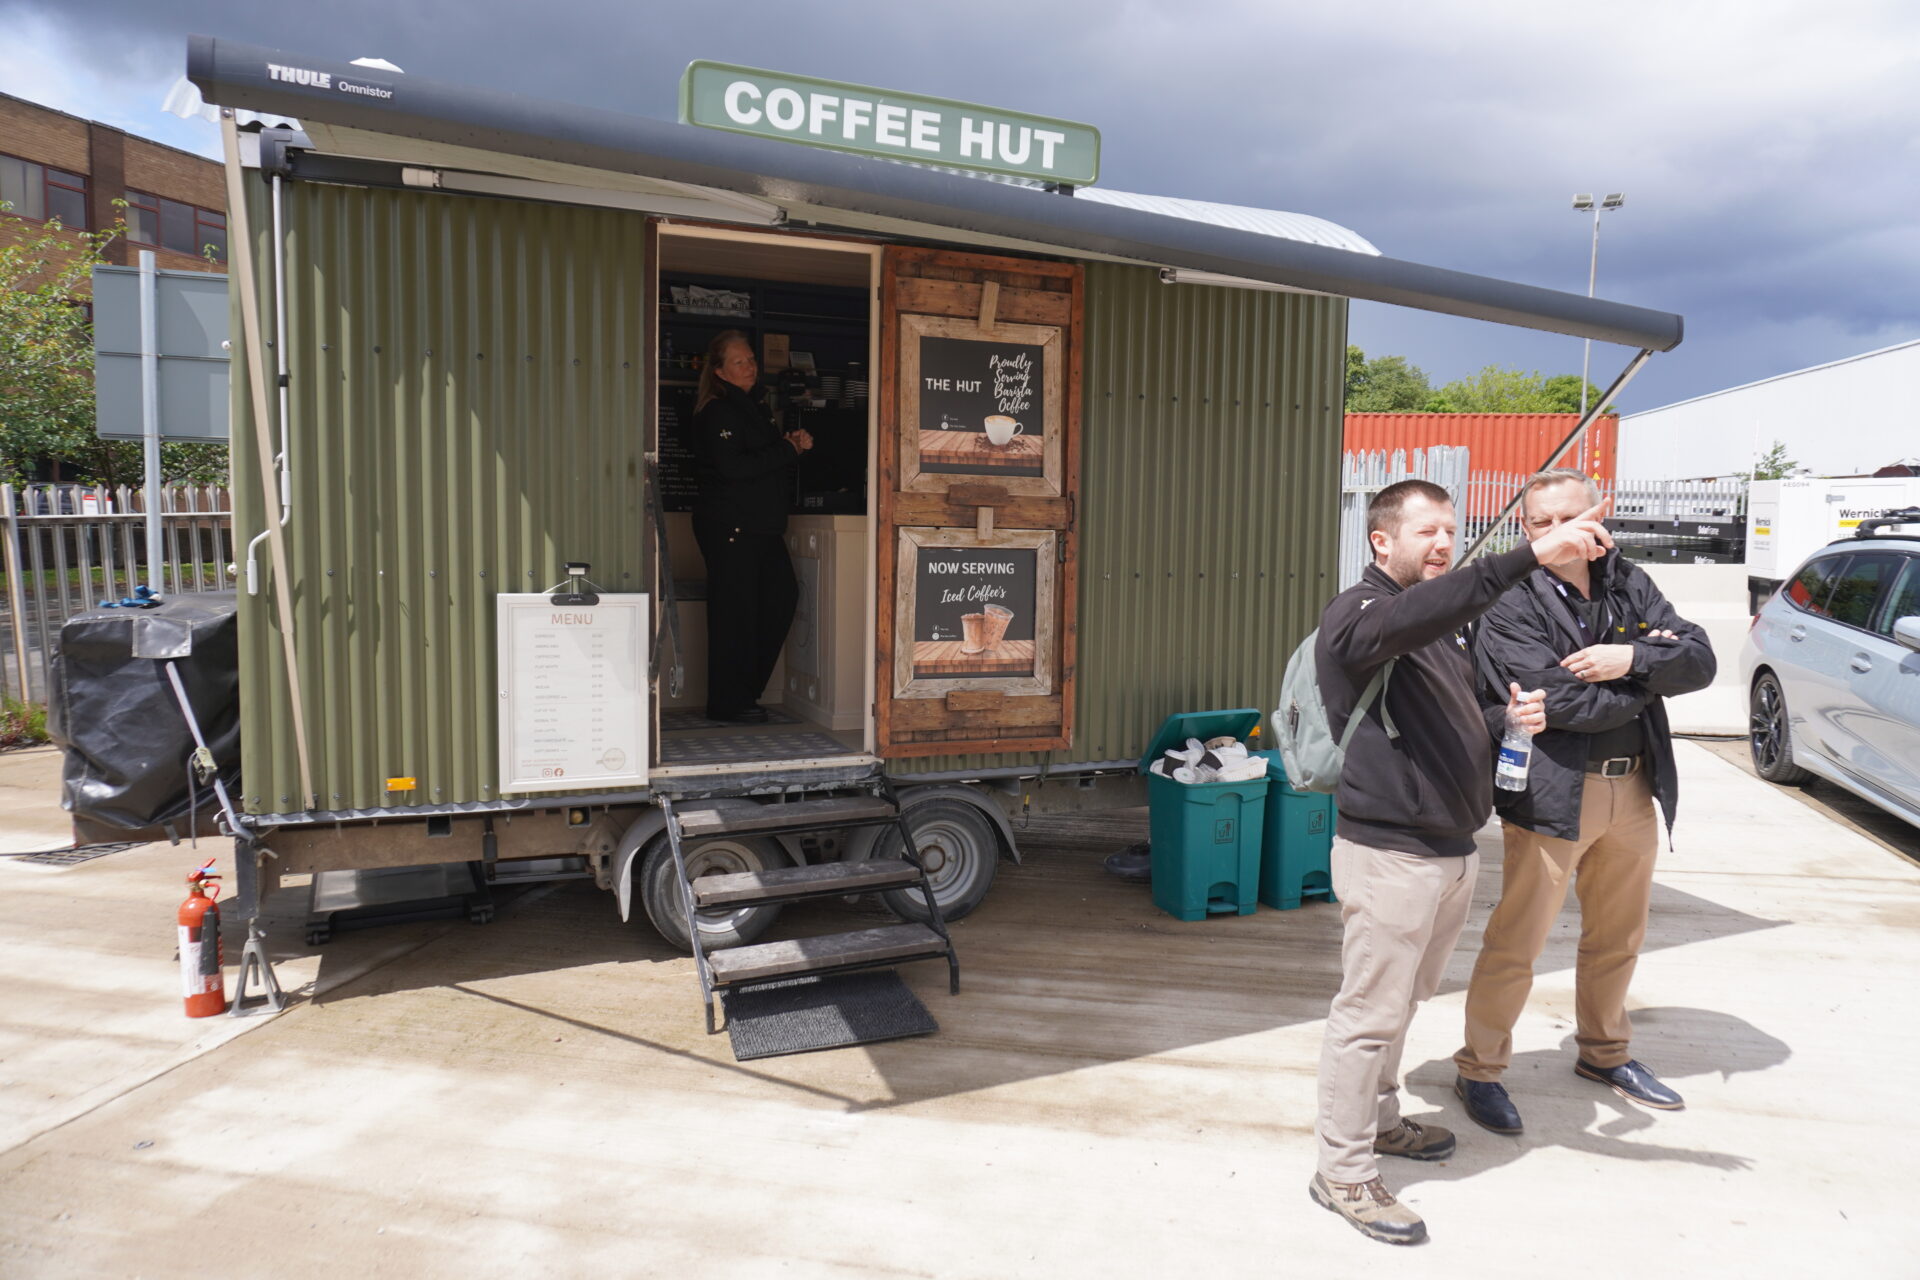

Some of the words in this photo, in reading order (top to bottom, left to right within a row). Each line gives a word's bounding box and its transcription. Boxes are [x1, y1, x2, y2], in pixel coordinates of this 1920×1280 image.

[268, 63, 331, 88] THULE
[338, 81, 393, 98] Omnistor
[724, 81, 941, 152] COFFEE
[960, 117, 1065, 169] HUT
[989, 353, 1033, 373] Proudly
[925, 377, 951, 391] THE
[956, 380, 982, 393] HUT
[994, 368, 1031, 386] Serving
[994, 382, 1033, 399] Barista
[928, 562, 959, 574] NOW
[962, 562, 1015, 575] SERVING
[940, 587, 965, 603] Iced
[967, 584, 1007, 602] Coffee's
[551, 613, 593, 625] MENU
